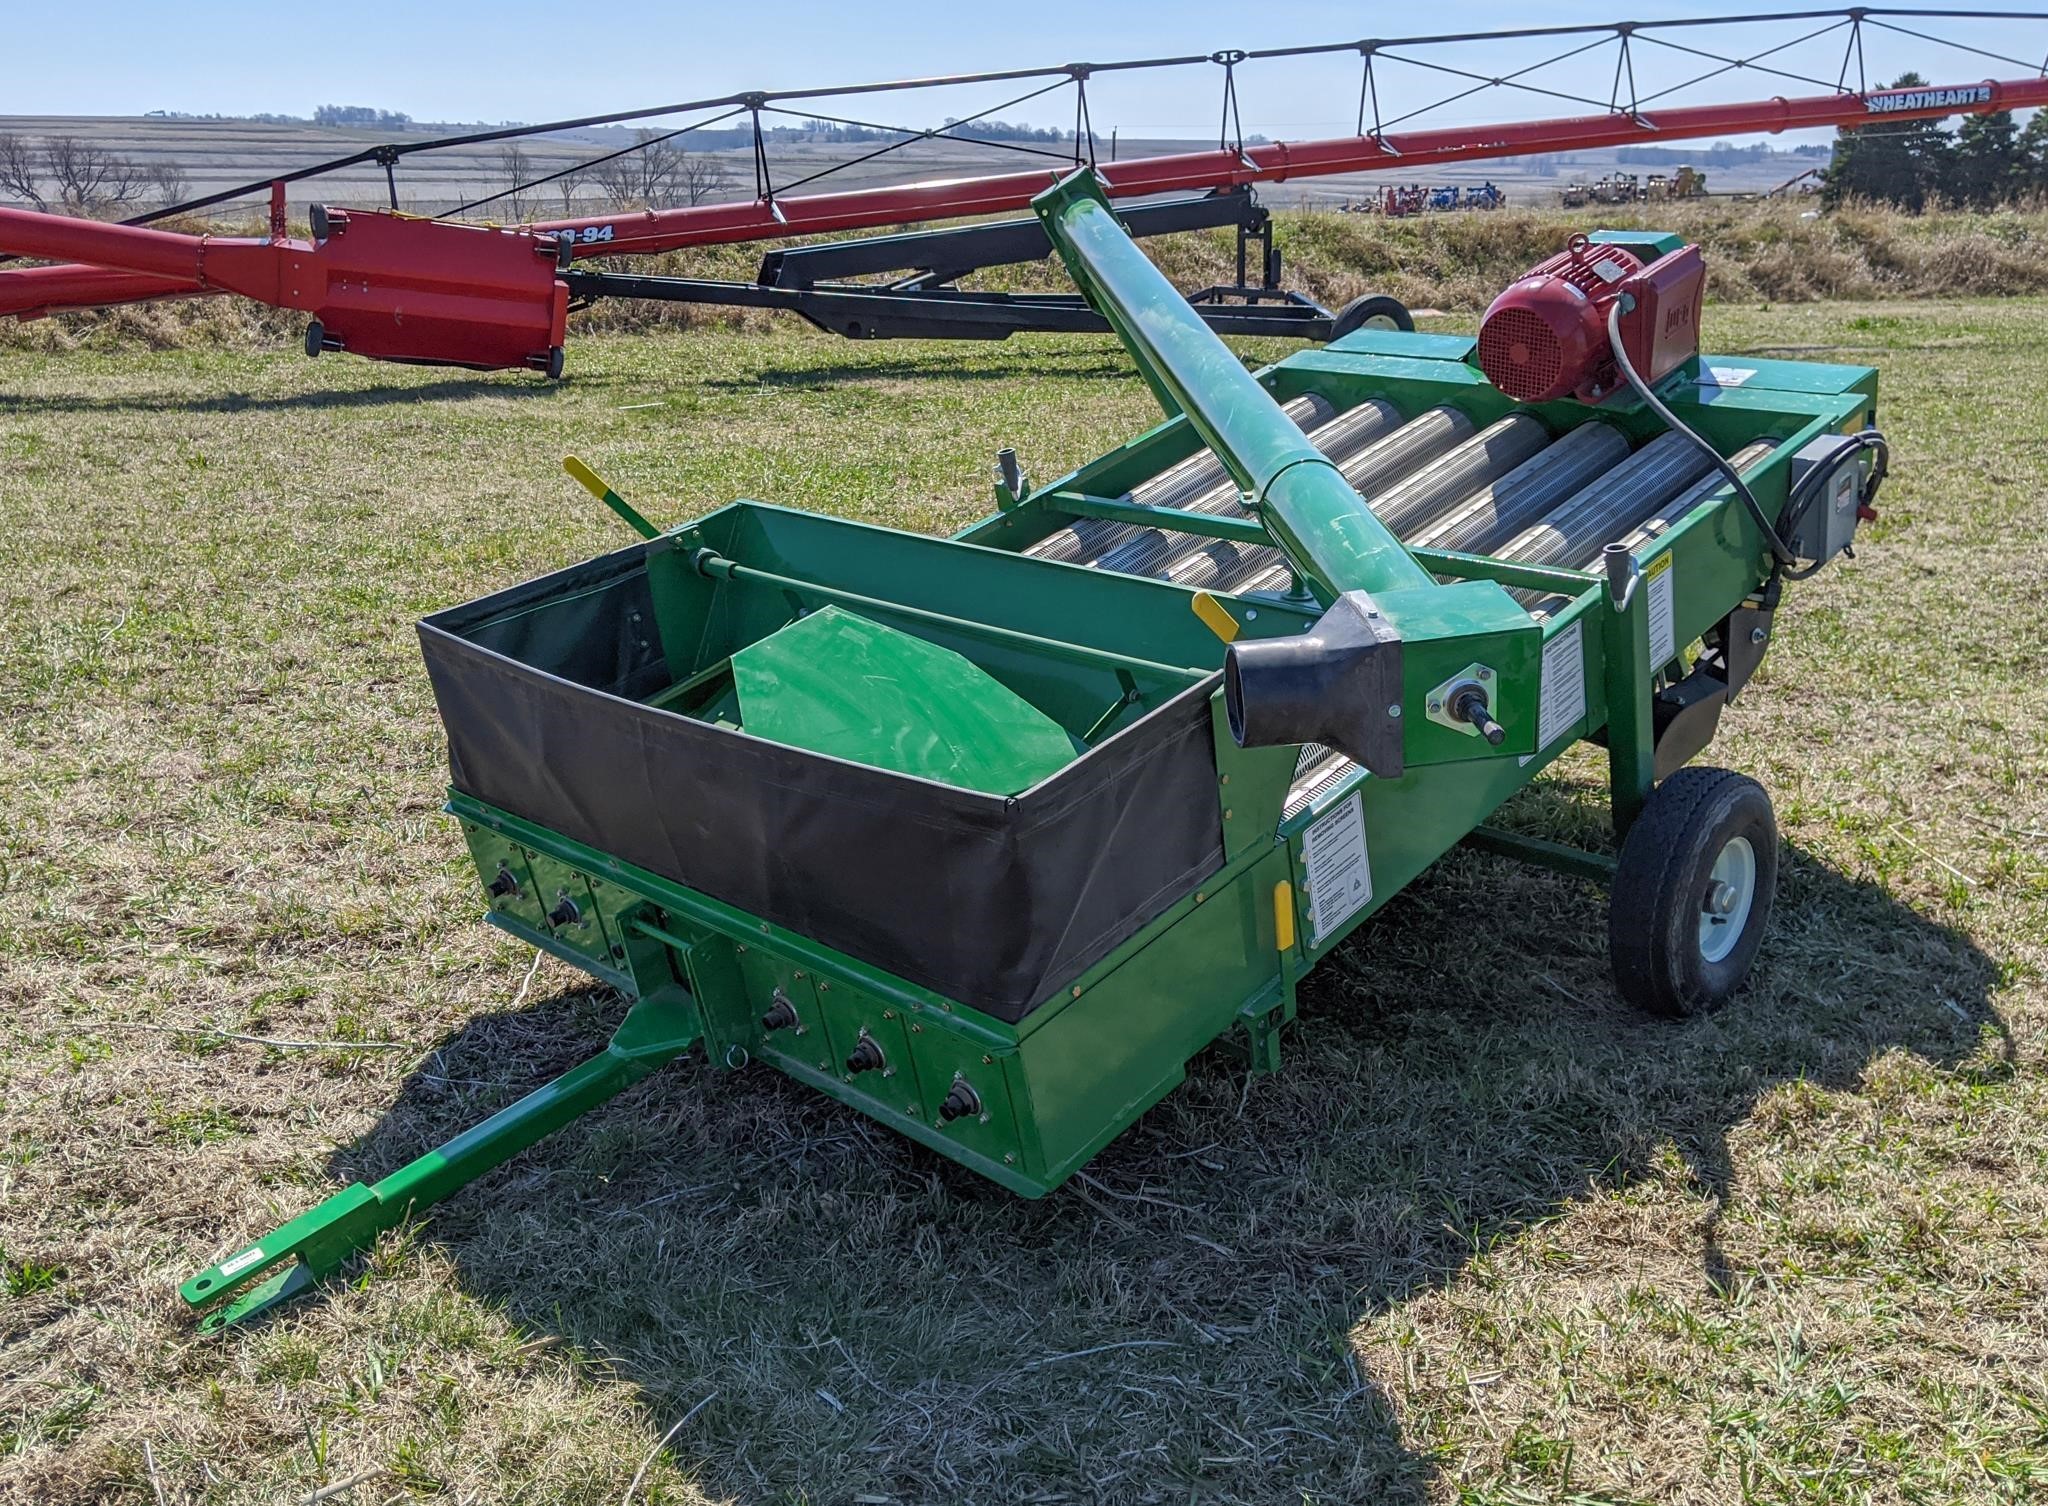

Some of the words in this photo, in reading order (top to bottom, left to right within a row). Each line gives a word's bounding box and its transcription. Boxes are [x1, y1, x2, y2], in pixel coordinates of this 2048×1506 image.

[1865, 88, 1977, 112] WHEATHEART
[1647, 555, 1670, 580] AUTION
[1311, 823, 1335, 844] REMOVING
[1335, 807, 1354, 825] SCREENS
[1312, 807, 1343, 836] INSTRUCTIONS
[1343, 801, 1353, 812] FOR
